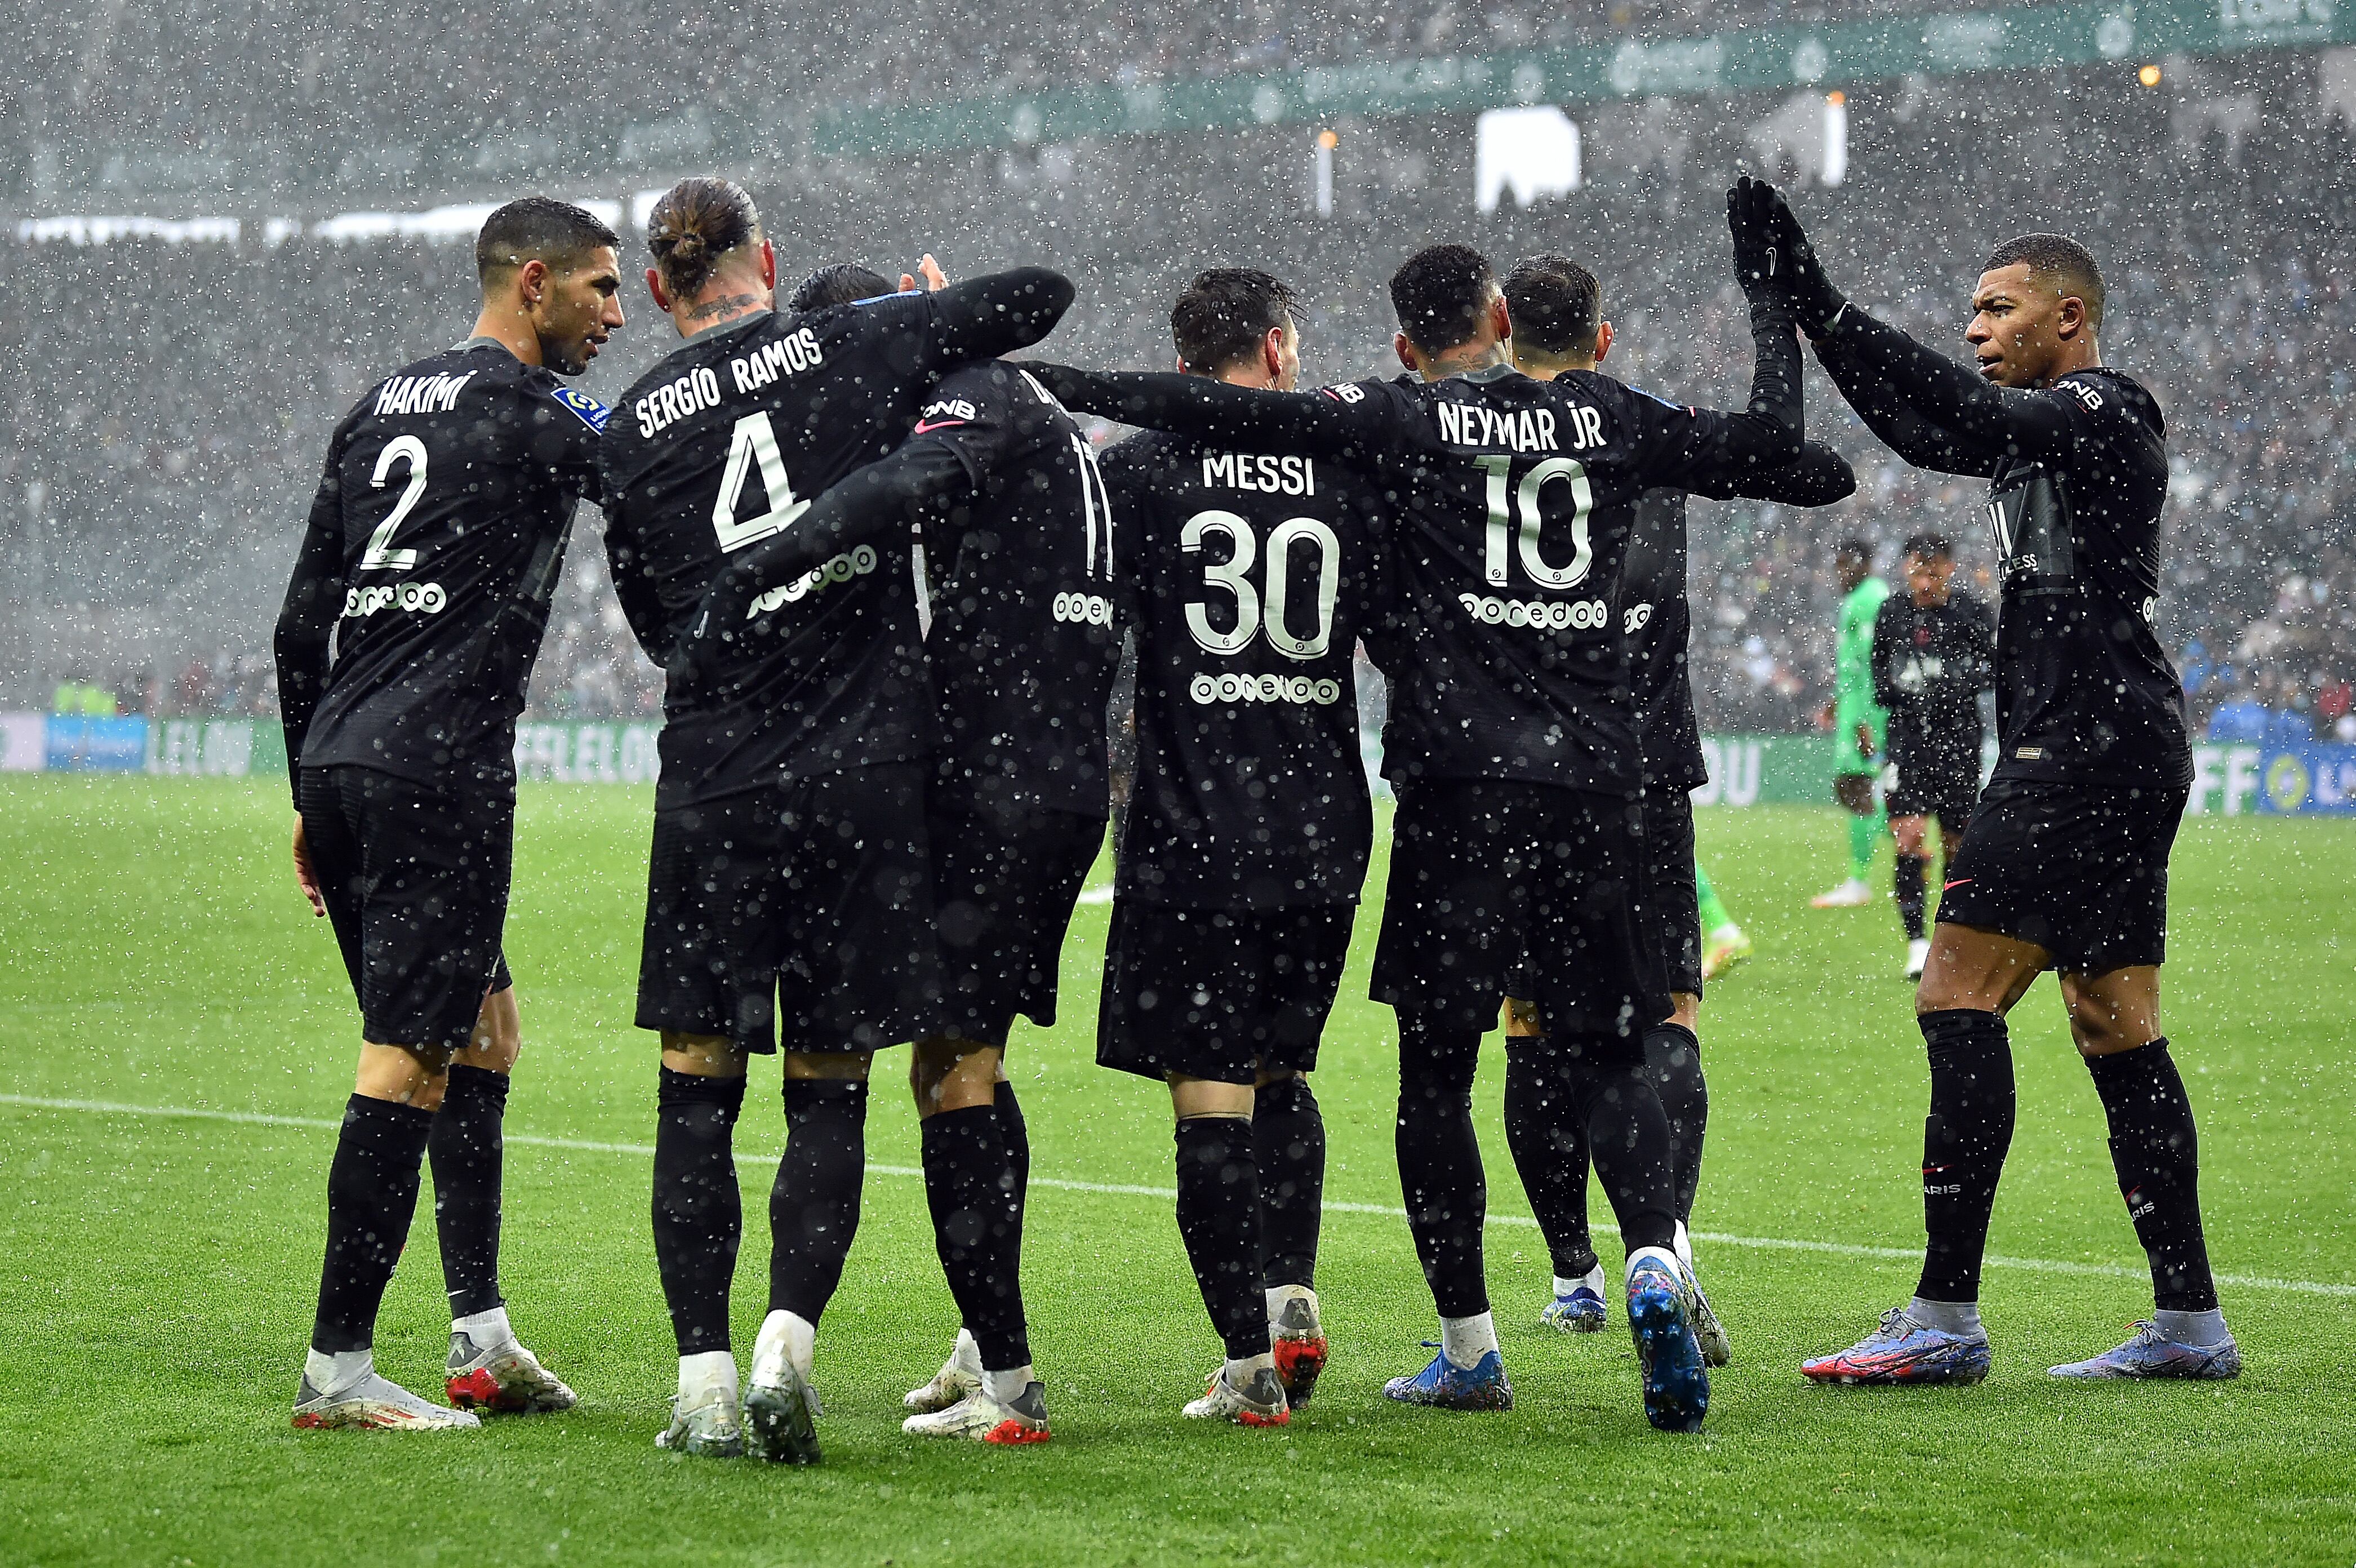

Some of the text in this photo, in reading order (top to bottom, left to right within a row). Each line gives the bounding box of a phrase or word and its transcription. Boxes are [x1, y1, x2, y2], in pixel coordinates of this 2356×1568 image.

[730, 327, 823, 394] RAMOS
[1330, 382, 1365, 404] NB
[1438, 401, 1559, 452] NEYMAR
[712, 411, 811, 553] 4
[1202, 448, 1315, 496] MESSI
[359, 434, 428, 570] 2
[1471, 455, 1593, 589] 10
[1180, 510, 1340, 660] 30
[1924, 1184, 1961, 1194] ARIS
[2132, 1202, 2155, 1221] RIS
